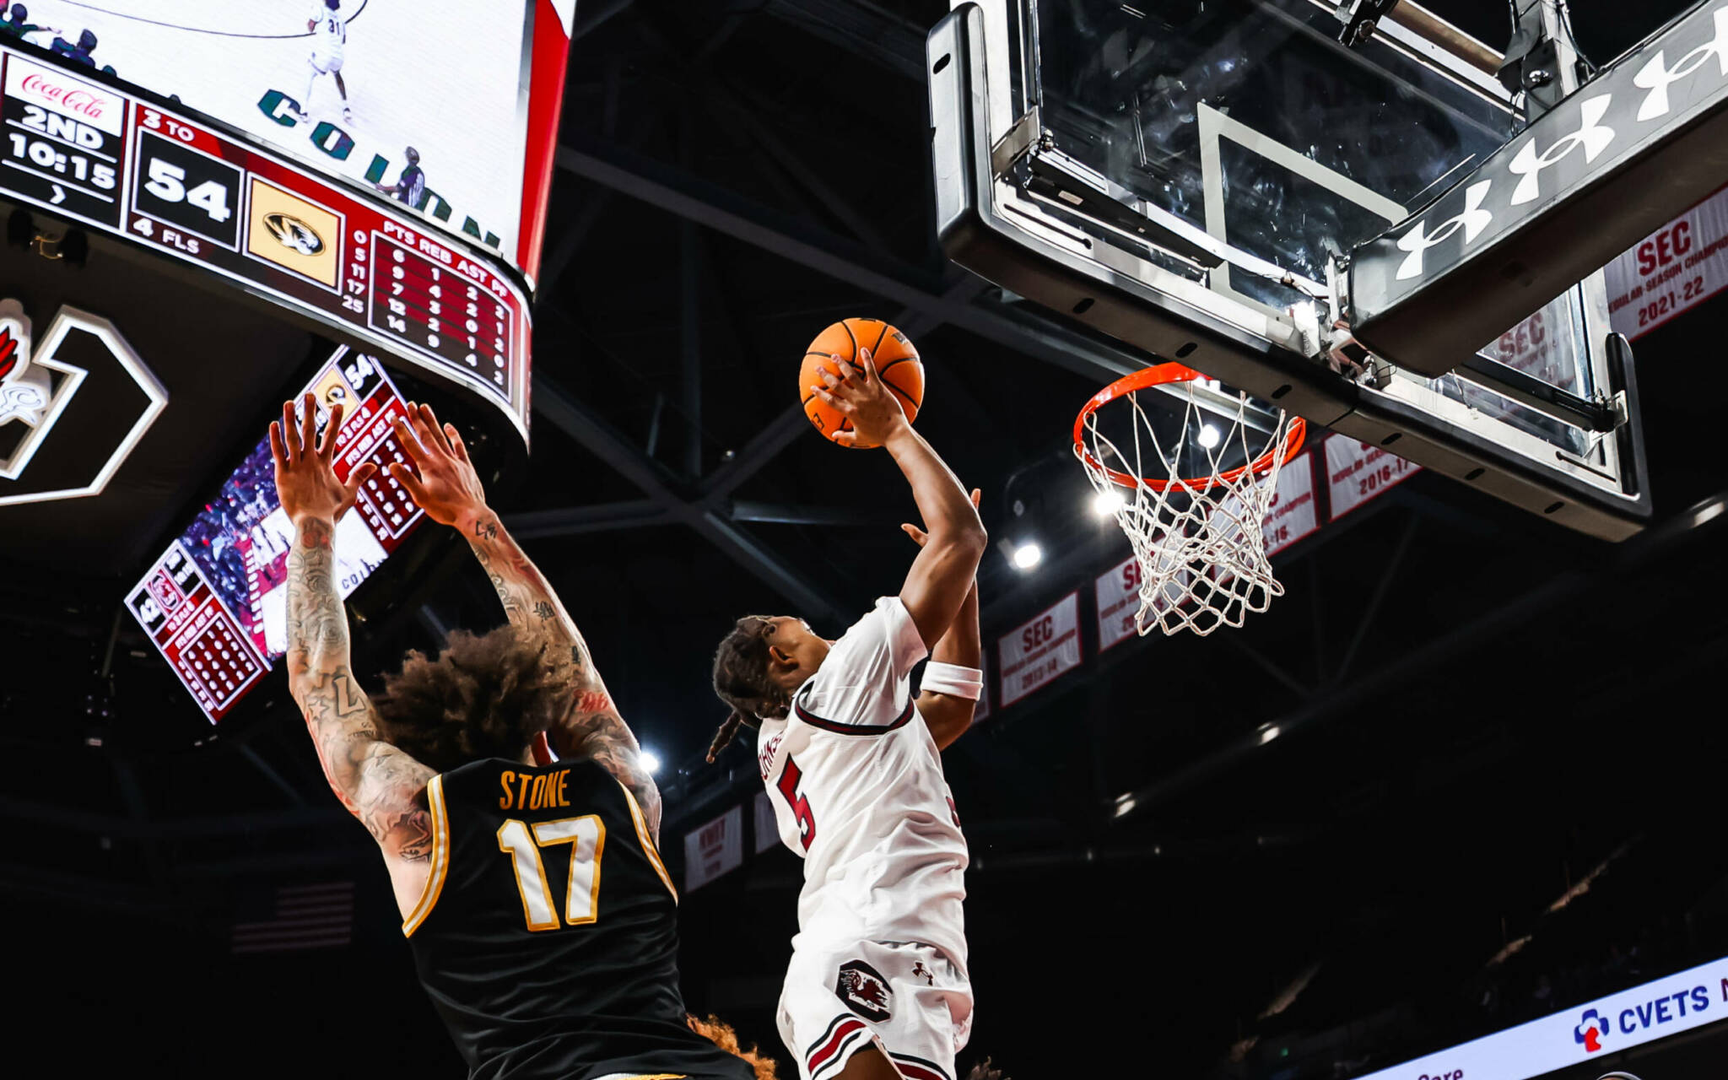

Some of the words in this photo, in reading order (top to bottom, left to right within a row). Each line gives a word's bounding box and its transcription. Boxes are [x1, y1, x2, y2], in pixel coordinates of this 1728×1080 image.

[22, 105, 104, 150] 2ND
[143, 109, 162, 130] 3
[166, 120, 195, 142] TO
[9, 133, 116, 190] 10:15
[144, 157, 231, 223] 54
[133, 218, 154, 237] 4
[163, 230, 200, 255] FLS
[384, 221, 415, 245] PTS
[420, 239, 452, 264] REB
[457, 261, 487, 282] AST
[1638, 221, 1691, 276] SEC
[354, 230, 367, 244] 0
[431, 268, 440, 281] 1
[467, 286, 478, 301] 2
[495, 305, 505, 320] 2
[392, 266, 404, 279] 9
[429, 285, 441, 298] 4
[466, 303, 478, 317] 2
[496, 322, 504, 335] 1
[1639, 276, 1704, 327] 2021-22
[347, 279, 365, 295] 17
[428, 318, 440, 332] 2
[467, 336, 476, 349] 1
[351, 263, 365, 279] 11
[391, 282, 404, 295] 7
[429, 301, 441, 315] 3
[465, 319, 478, 333] 0
[495, 338, 504, 352] 2
[342, 295, 364, 313] 25
[387, 315, 406, 333] 14
[465, 353, 477, 367] 4
[494, 371, 503, 385] 2
[1499, 312, 1545, 363] SEC
[344, 353, 375, 390] 54
[140, 598, 161, 624] 42
[1022, 615, 1053, 653] SEC
[499, 769, 571, 811] STONE
[776, 751, 816, 853] 5
[496, 813, 607, 932] 17
[1619, 985, 1710, 1034] CVETS
